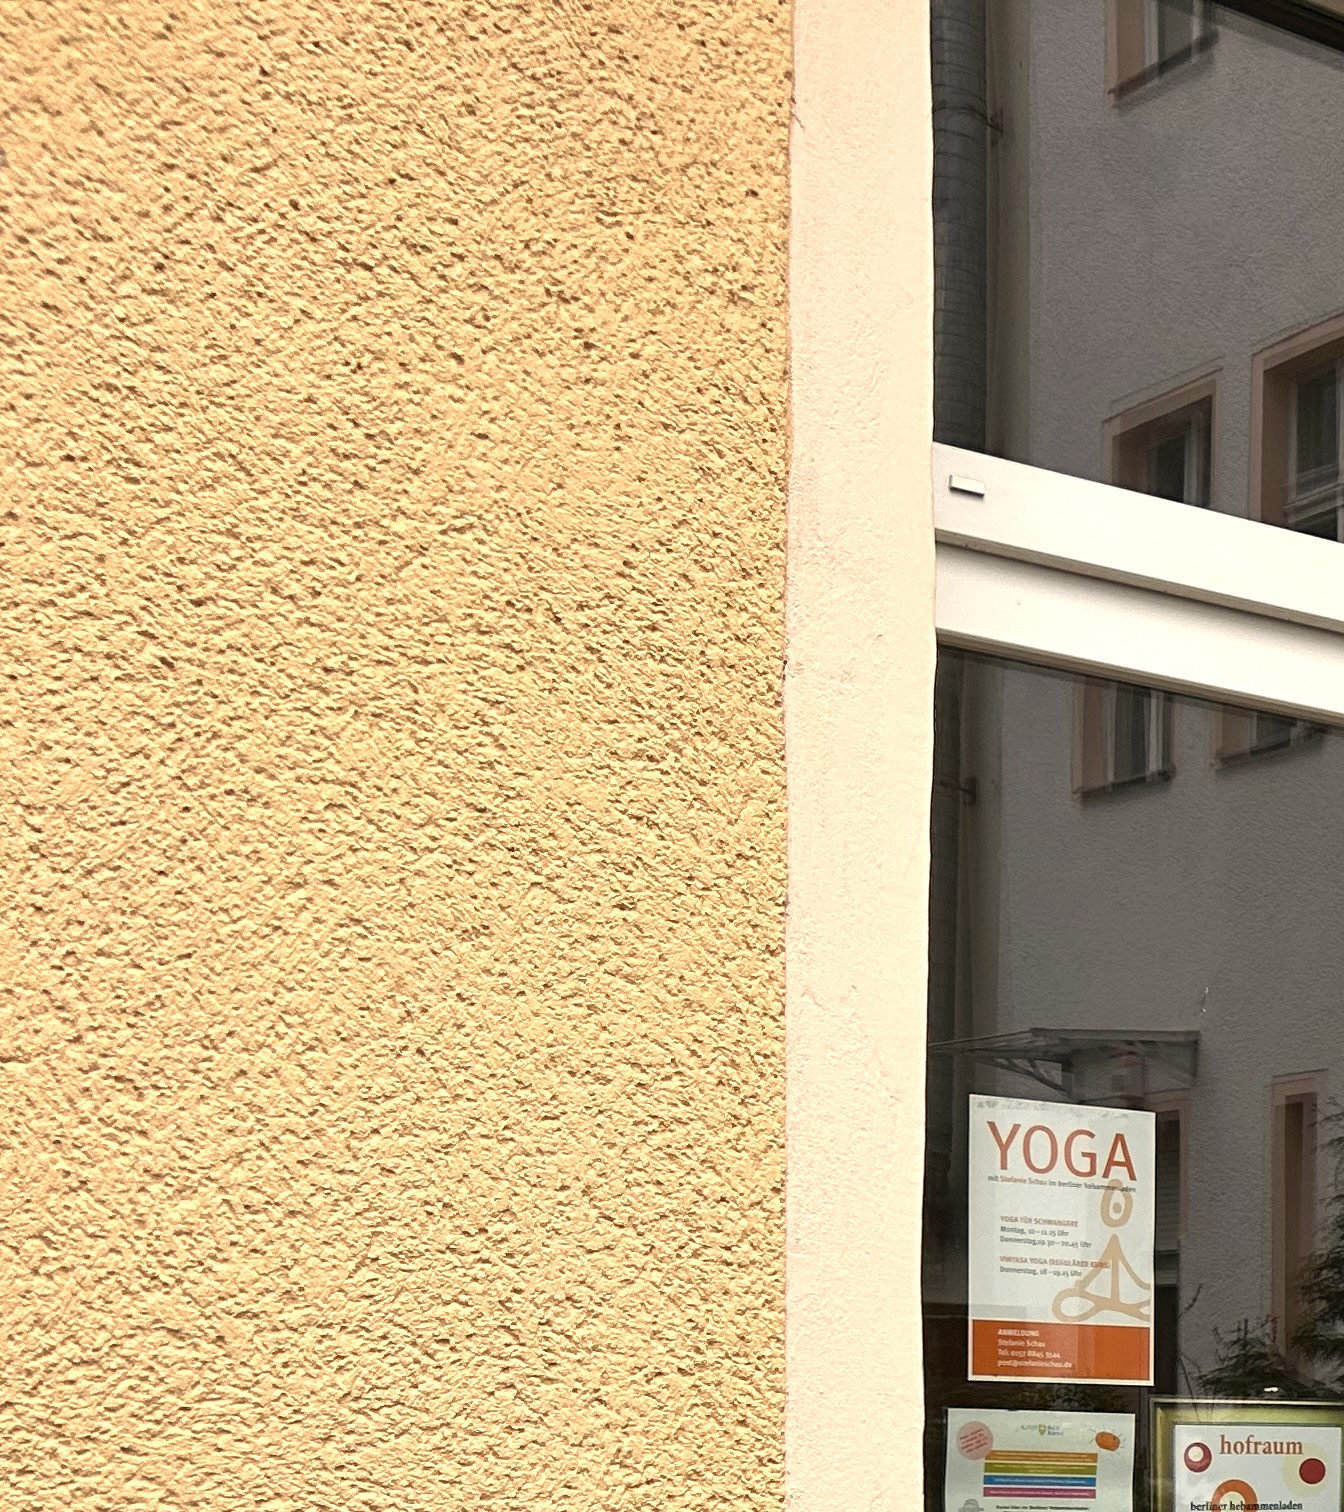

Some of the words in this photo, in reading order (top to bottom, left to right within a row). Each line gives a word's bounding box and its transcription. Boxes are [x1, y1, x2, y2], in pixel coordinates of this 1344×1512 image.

[986, 1120, 1137, 1182] YOGA
[987, 1174, 999, 1183] mit
[1000, 1175, 1027, 1184] Stefanie
[1028, 1177, 1047, 1186] Schau
[1058, 1180, 1082, 1190] berliner
[1000, 1215, 1019, 1224] YOGA
[1020, 1214, 1032, 1225] FÜR
[1033, 1217, 1079, 1228] SCHWANGERE
[1057, 1229, 1070, 1237] Uhr
[1080, 1240, 1092, 1248] Uhr
[1028, 1257, 1048, 1266] YOGA
[1070, 1269, 1082, 1278] Uhr
[997, 1328, 1040, 1337] ANMELDUNG
[997, 1338, 1026, 1347] Stefanie
[1026, 1339, 1046, 1348] Schau
[1219, 1434, 1304, 1456] hofraum
[1190, 1500, 1227, 1511] berliner
[1229, 1499, 1303, 1511] hebammenladen
